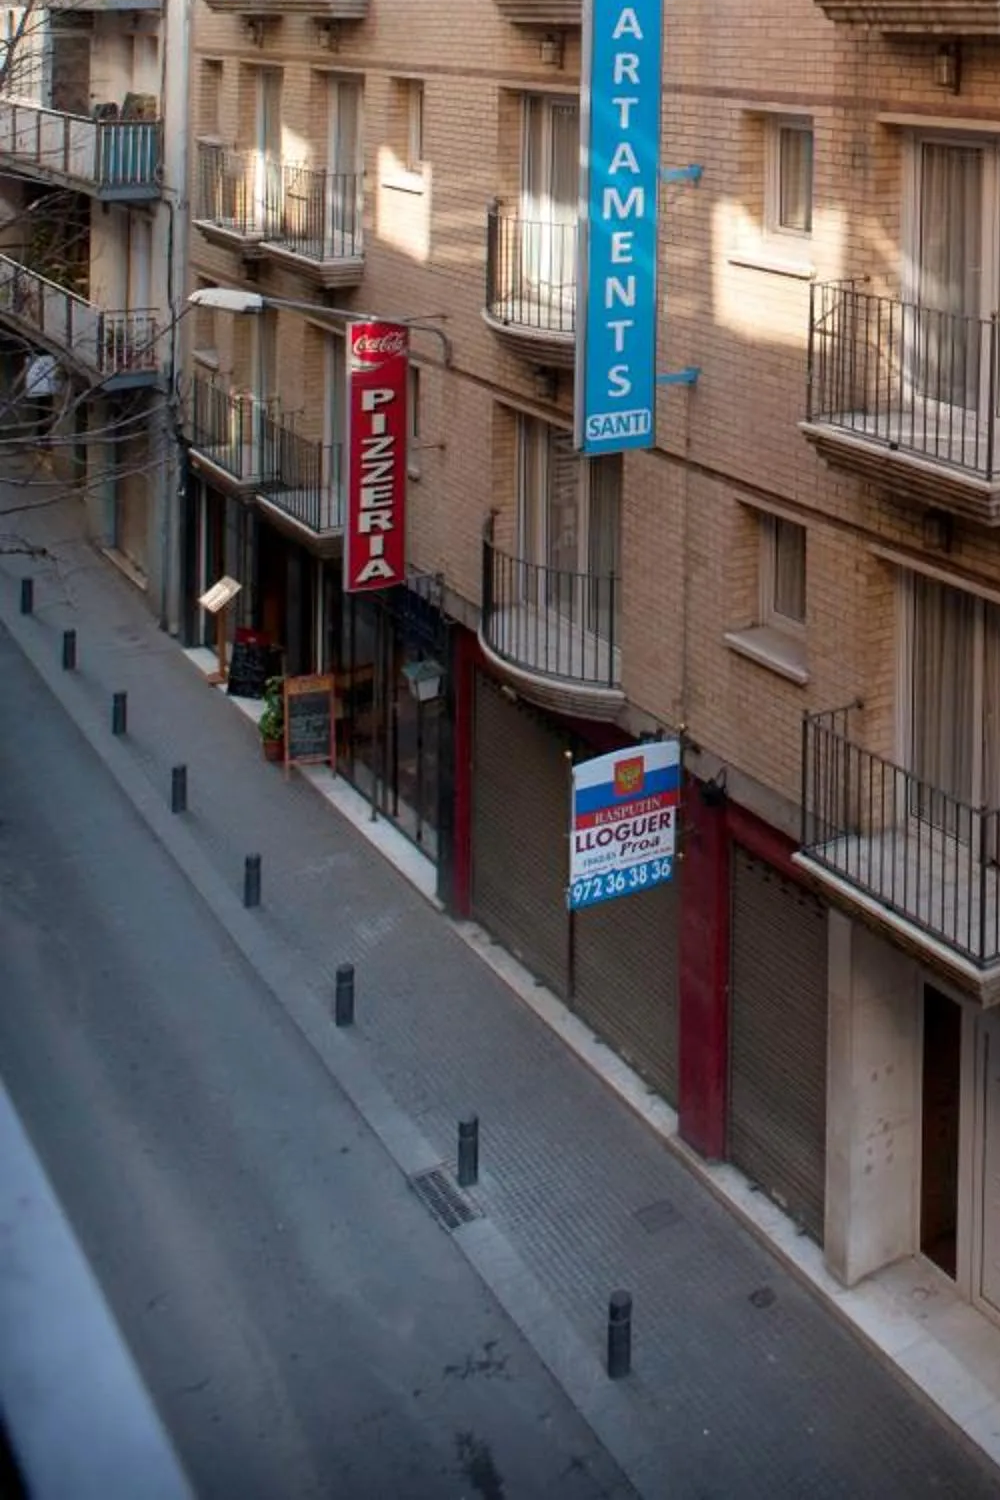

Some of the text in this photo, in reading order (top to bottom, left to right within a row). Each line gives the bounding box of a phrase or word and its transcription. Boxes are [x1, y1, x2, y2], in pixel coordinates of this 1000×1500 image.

[589, 411, 648, 437] SANTI
[355, 387, 396, 583] PIZZERIA
[593, 796, 662, 824] RASPUTIN
[575, 811, 671, 852] LLOGUER
[619, 836, 661, 857] Proa
[572, 877, 602, 903] 972
[605, 870, 625, 894] 36
[629, 864, 648, 887] 38
[651, 858, 671, 881] 36
